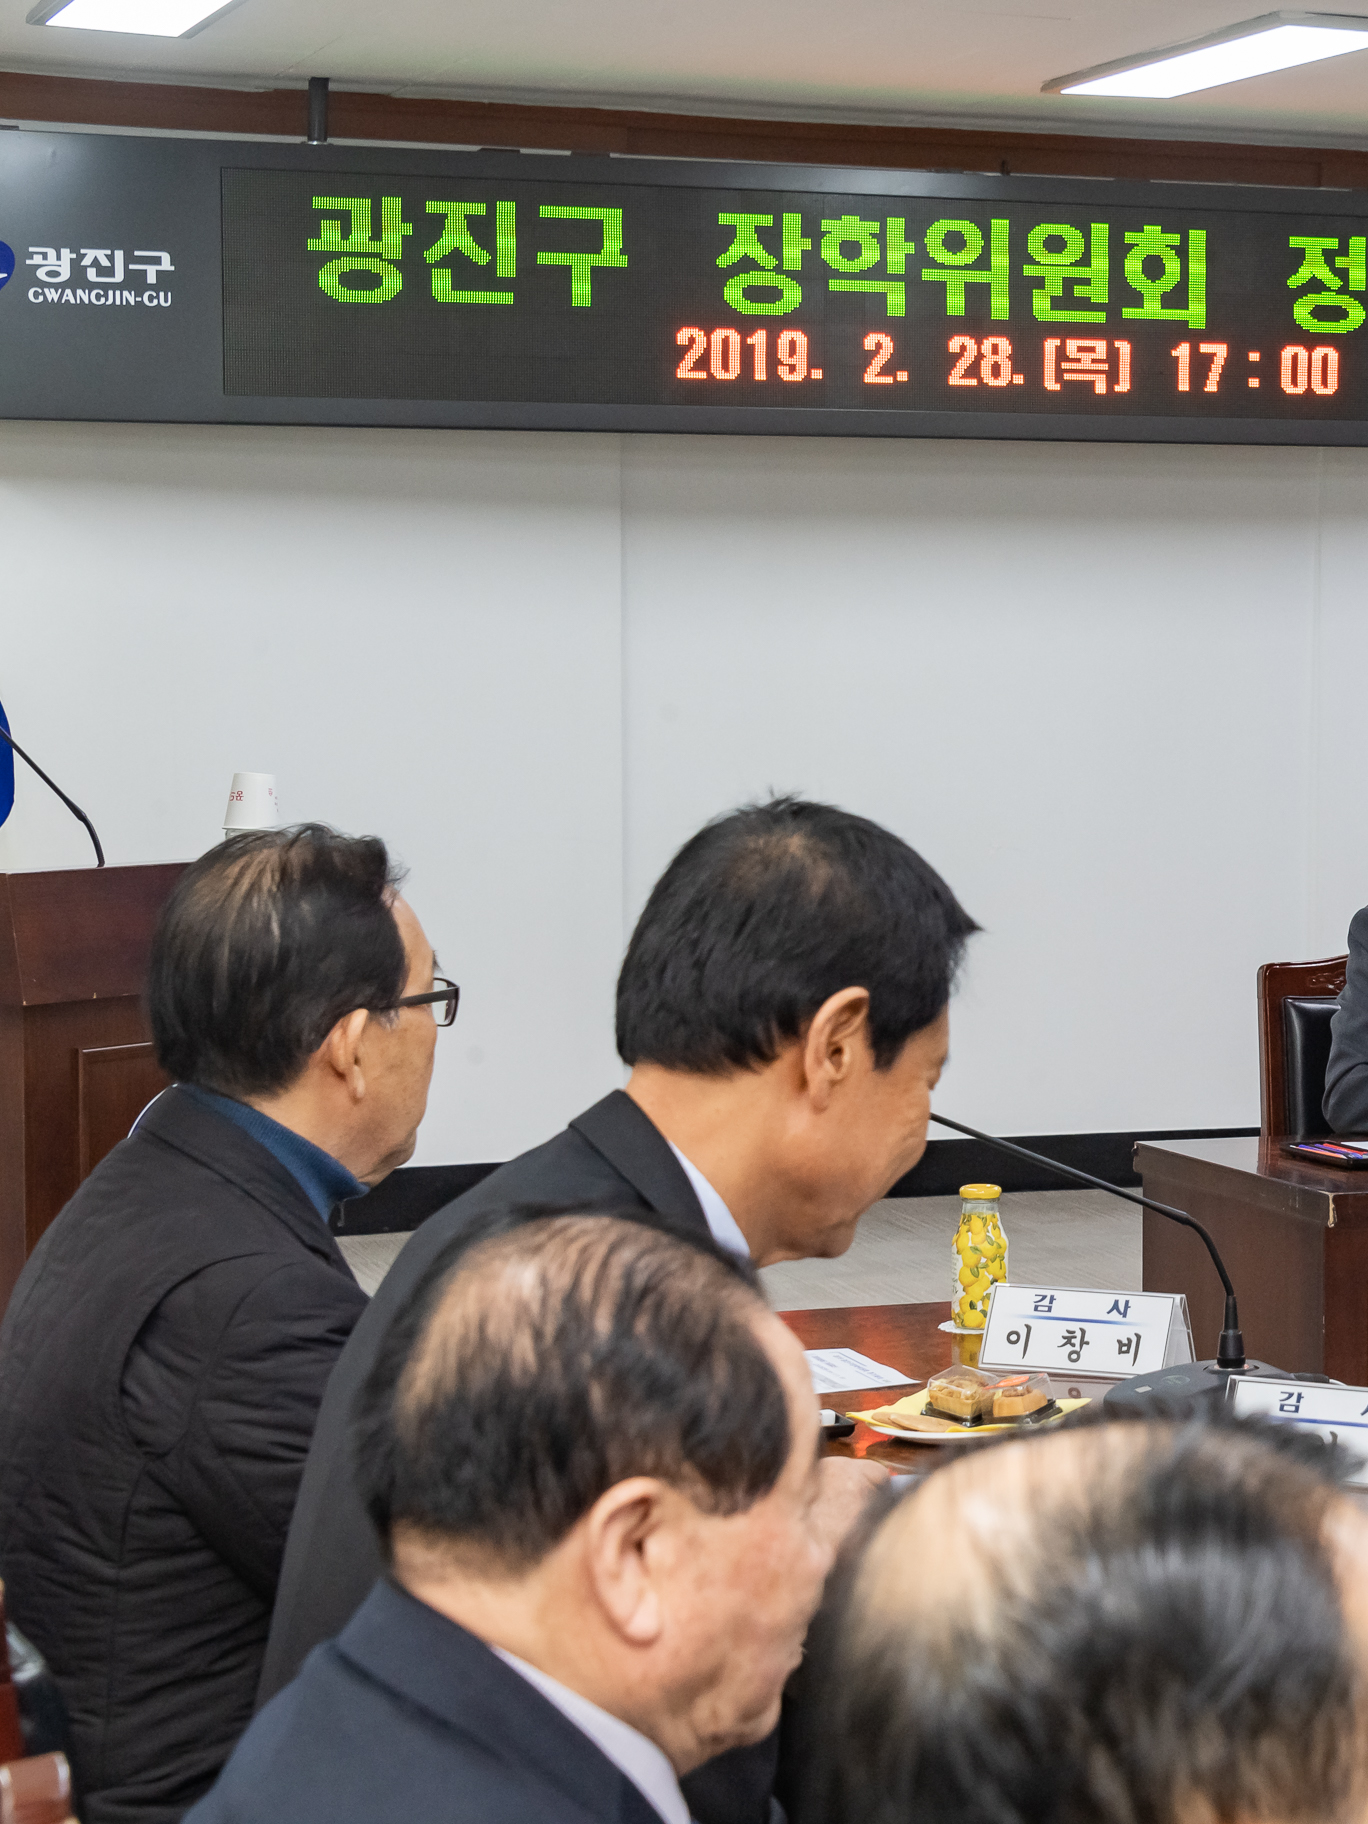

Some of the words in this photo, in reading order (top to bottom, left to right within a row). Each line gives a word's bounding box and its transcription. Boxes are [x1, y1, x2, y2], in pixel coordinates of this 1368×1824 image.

[26, 246, 175, 284] 광진구
[308, 196, 628, 307] 광진구
[716, 212, 1206, 329] 장학위원회
[28, 287, 172, 307] GWANGJIN-GU
[675, 327, 823, 381] 2019.
[863, 333, 909, 384] 2.
